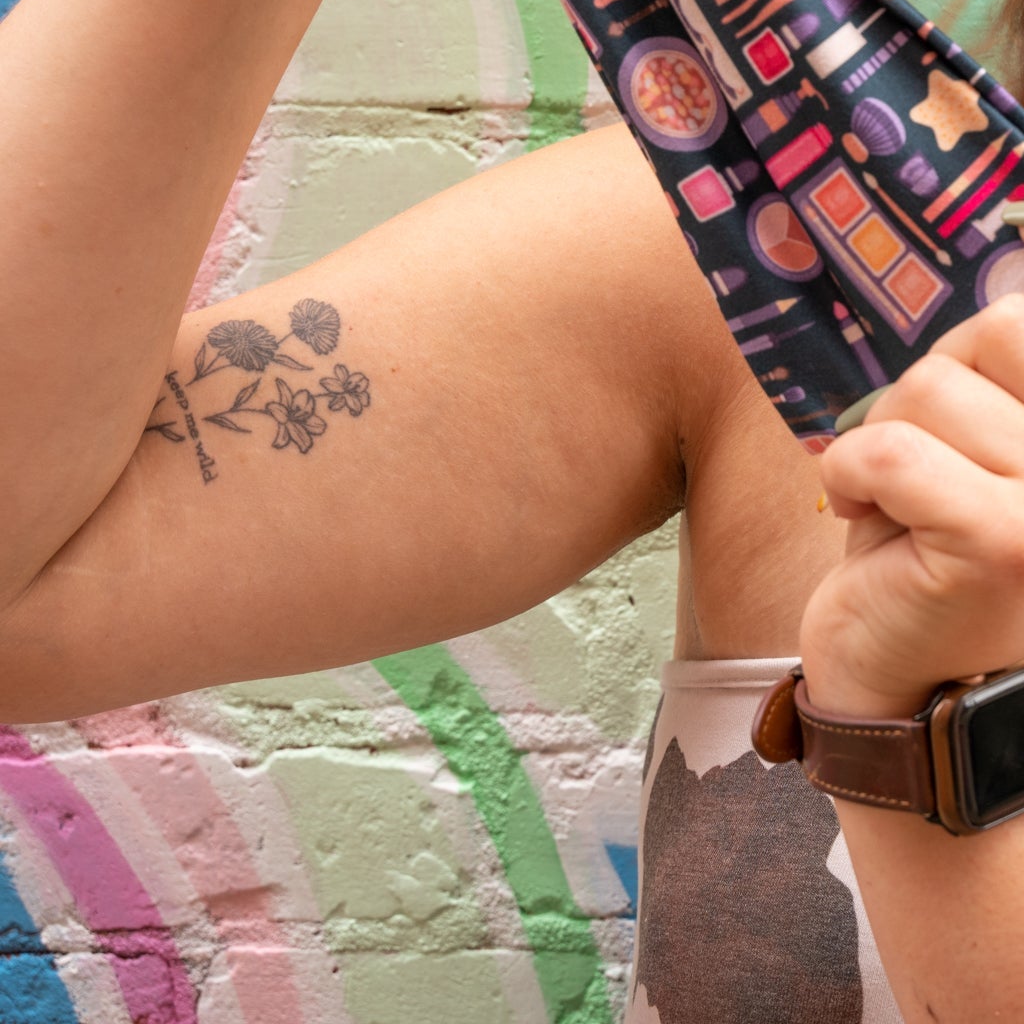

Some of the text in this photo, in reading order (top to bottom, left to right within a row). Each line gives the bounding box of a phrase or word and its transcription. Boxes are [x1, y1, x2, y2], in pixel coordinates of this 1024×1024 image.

[165, 370, 218, 484] keep me wild
